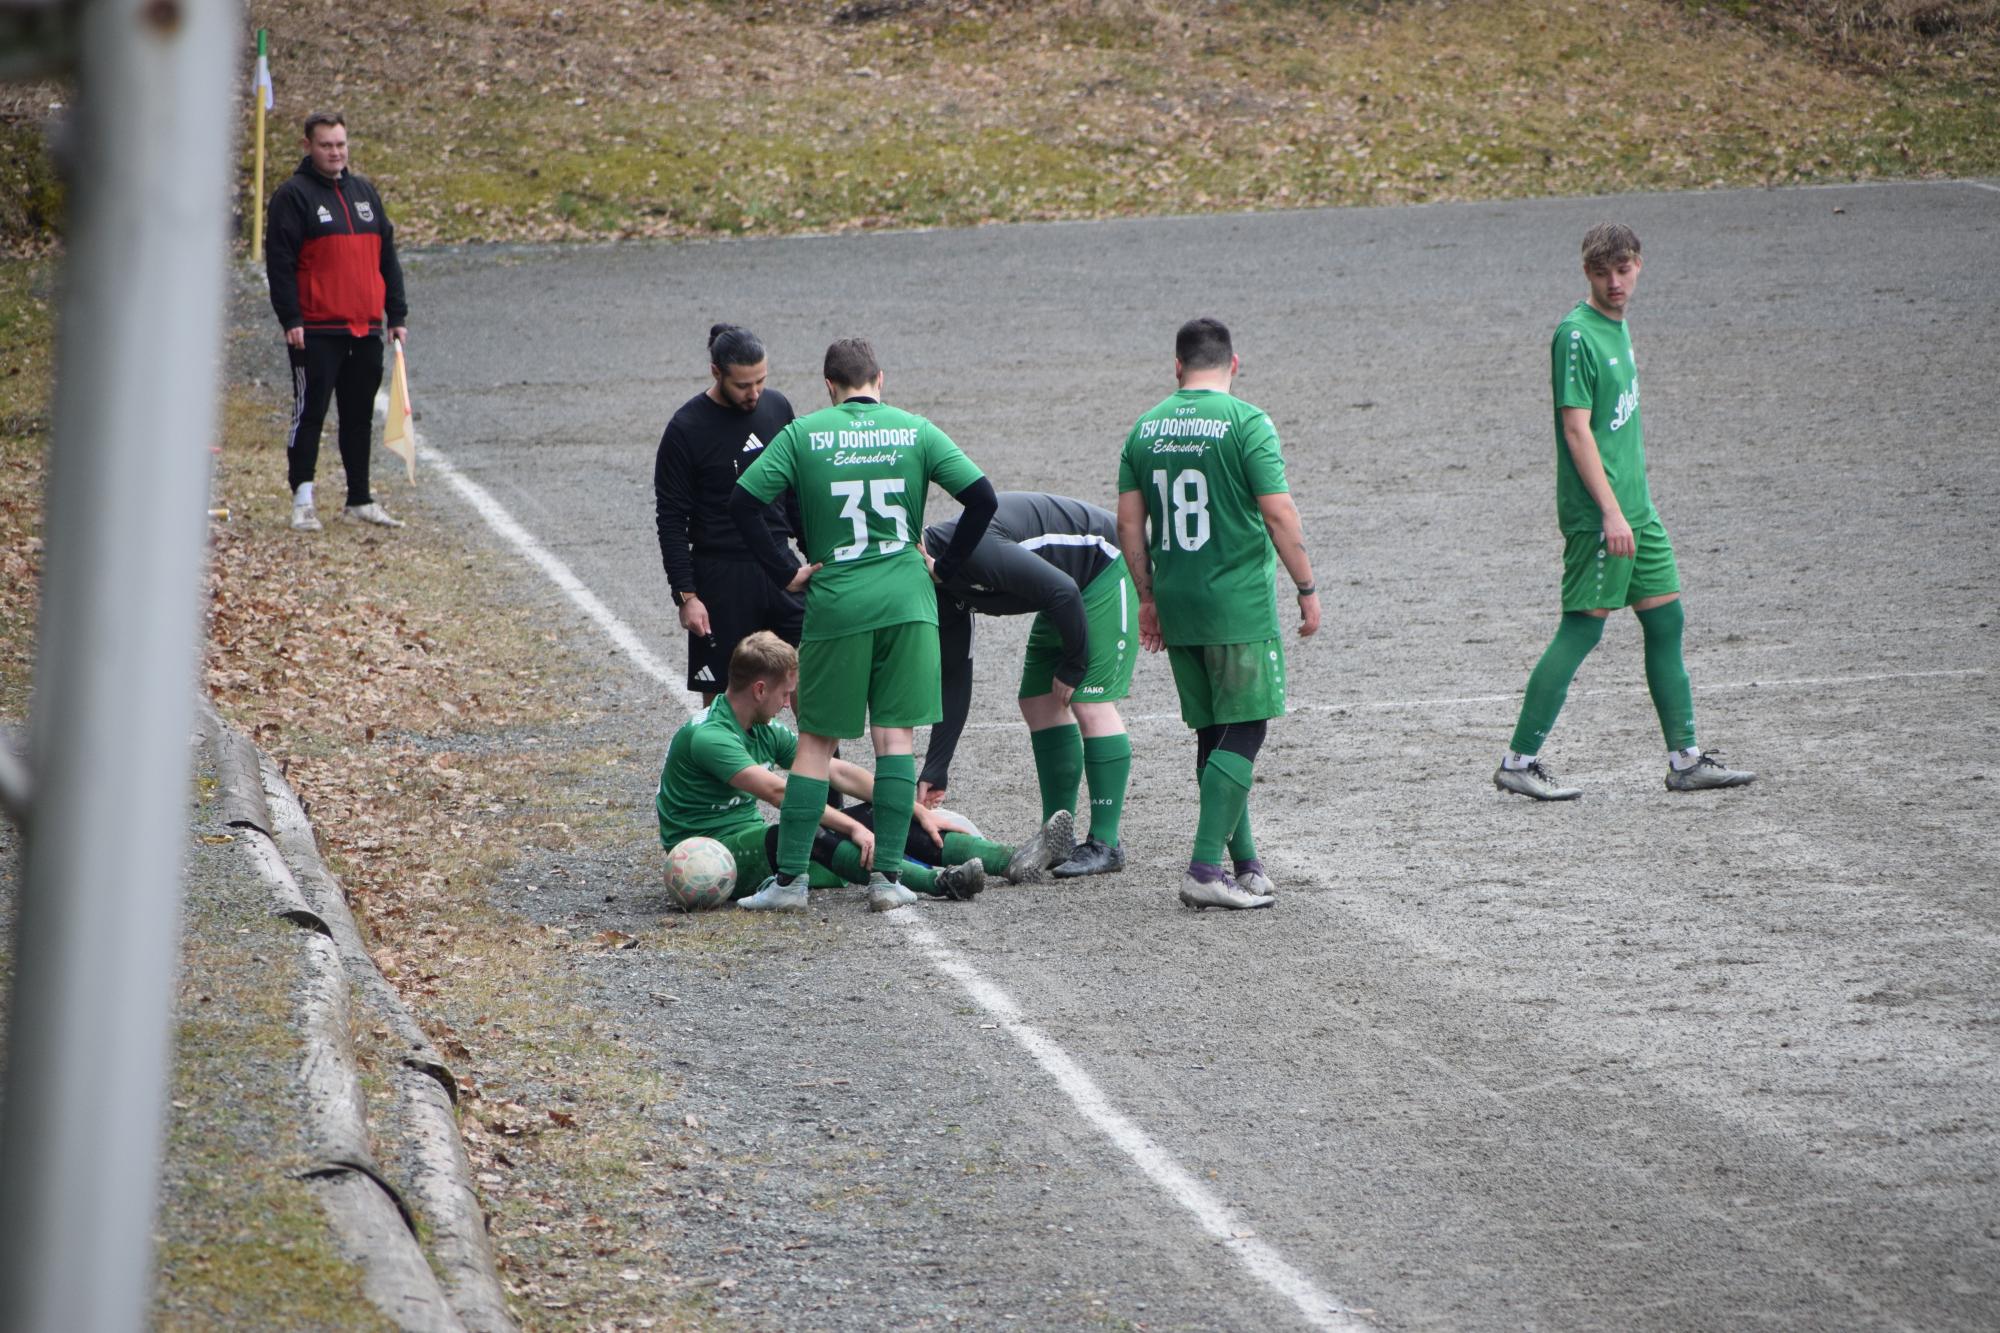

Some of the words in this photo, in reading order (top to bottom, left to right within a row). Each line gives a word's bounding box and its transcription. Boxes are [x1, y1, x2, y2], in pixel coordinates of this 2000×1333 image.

[1175, 407, 1196, 415] 1910
[849, 420, 875, 428] 1910
[1139, 419, 1160, 439] TSV
[1160, 418, 1232, 439] DONNDORF
[808, 431, 834, 450] TSV
[838, 428, 918, 449] DONNDORF
[1152, 469, 1211, 551] 18
[830, 478, 910, 561] 35
[1082, 686, 1104, 694] JAKO
[1091, 798, 1113, 806] AKO
